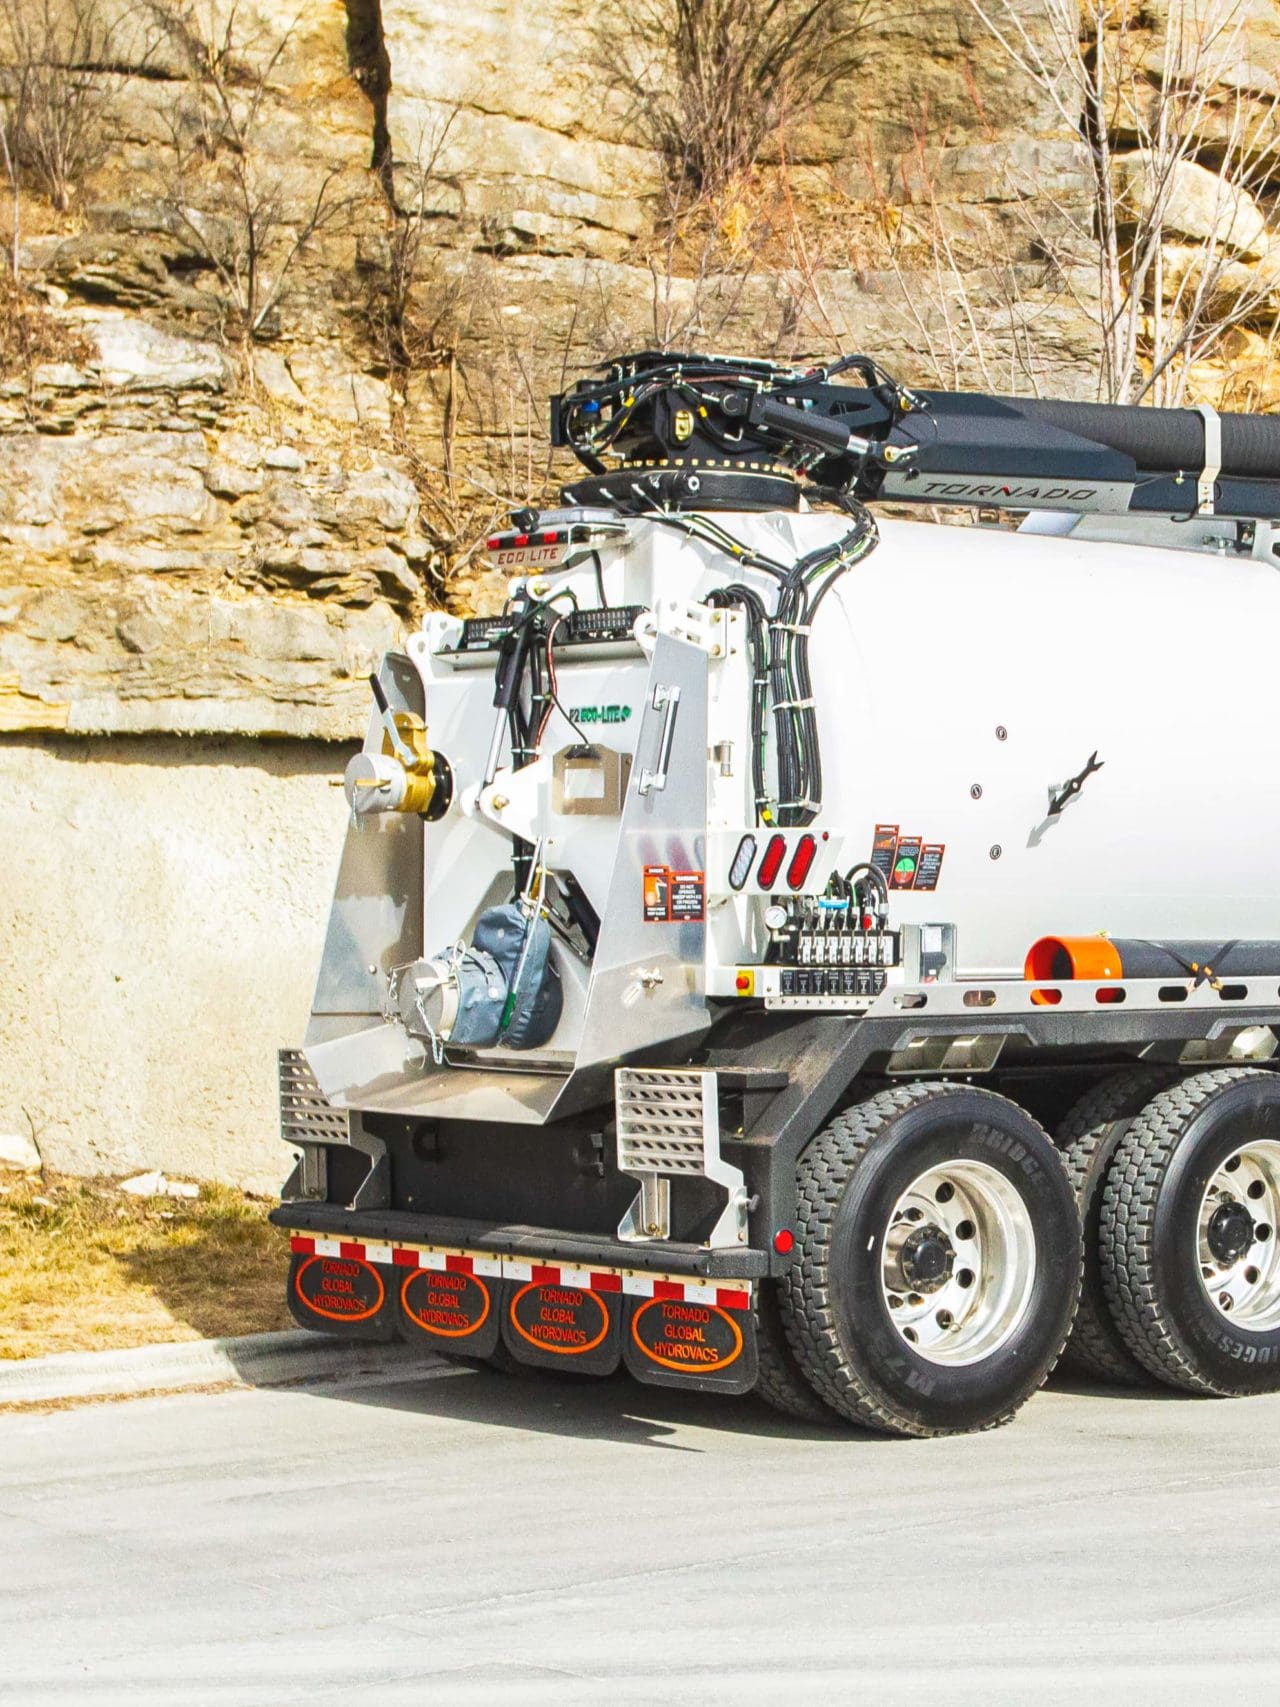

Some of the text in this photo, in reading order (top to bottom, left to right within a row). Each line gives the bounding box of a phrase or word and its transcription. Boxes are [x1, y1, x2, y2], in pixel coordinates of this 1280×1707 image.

[923, 482, 1098, 500] TORNADO
[498, 547, 558, 565] ECO LITE
[321, 1260, 360, 1278] TORNADO
[322, 1278, 354, 1294] GLOBAL
[425, 1273, 467, 1291] TORNADO
[313, 1294, 366, 1312] HYDROVACS
[427, 1292, 460, 1309] GLOBAL
[538, 1288, 583, 1306] TORNADO
[418, 1308, 470, 1329] HYDROVACS
[540, 1308, 576, 1325] GLOBAL
[661, 1303, 711, 1324] TORNADO
[530, 1324, 587, 1345] HYDROVACS
[664, 1324, 706, 1343] GLOBAL
[654, 1341, 719, 1363] HYDROVACS
